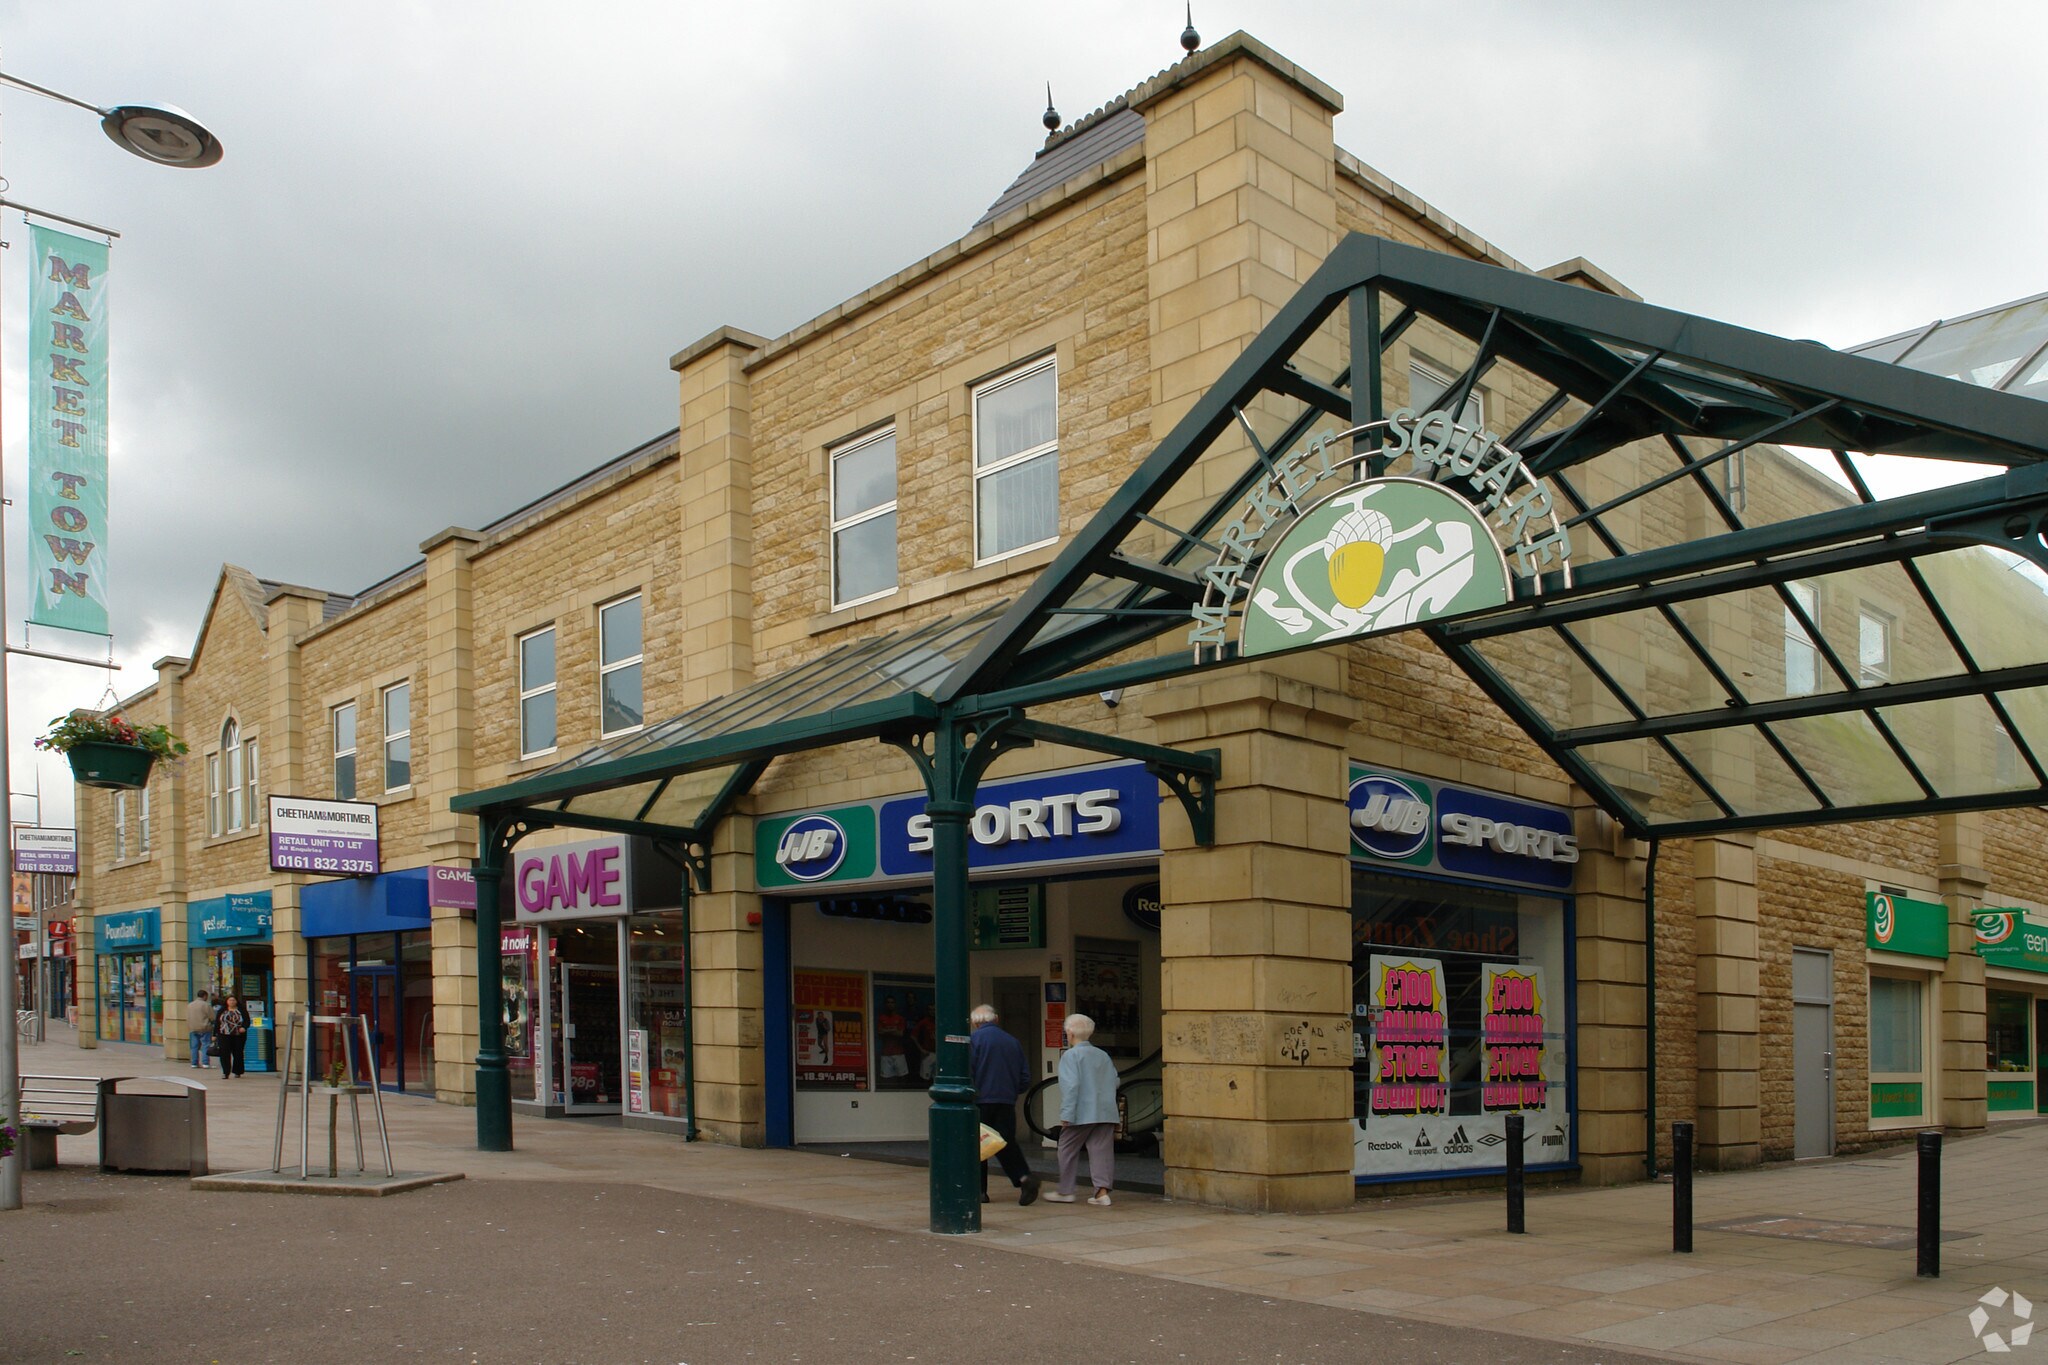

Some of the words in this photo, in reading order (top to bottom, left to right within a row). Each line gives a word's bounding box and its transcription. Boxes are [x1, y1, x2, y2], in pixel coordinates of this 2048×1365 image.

[47, 255, 91, 448] MARKET
[44, 471, 95, 599] TOWN
[1188, 428, 1337, 646] MARKET
[1381, 408, 1572, 577] SQUARE
[775, 829, 837, 864] JJB
[907, 788, 1121, 852] SORTS
[1351, 794, 1430, 836] JJB
[1441, 813, 1579, 864] SPORTS
[279, 837, 308, 846] RETAIL
[311, 839, 330, 847] UNIT
[333, 840, 344, 848] TO
[347, 841, 362, 849] LET
[39, 863, 53, 871] 832
[55, 864, 74, 872] 3375
[278, 855, 309, 868] 0161
[314, 857, 338, 870] 832
[342, 859, 373, 872] 3375
[437, 870, 475, 883] GAME
[518, 846, 621, 913] GAME
[232, 897, 253, 905] yes!
[105, 919, 136, 940] Poundland
[203, 915, 216, 934] yes!
[257, 915, 273, 925] £1
[509, 934, 529, 949] now!
[795, 986, 863, 1008] OFFER
[1385, 968, 1433, 1007] £100
[1493, 974, 1533, 1011] £100
[1376, 1010, 1443, 1043] MILLION
[1485, 1013, 1543, 1044] MILLION
[1381, 1045, 1439, 1077] STOCK
[1490, 1046, 1538, 1077] STOCK
[803, 1072, 834, 1081] 18.9%
[836, 1073, 855, 1081] APR
[1420, 1083, 1446, 1109] OUT
[1523, 1081, 1546, 1104] OUT
[1367, 1141, 1402, 1151] Reebok
[1443, 1143, 1473, 1154] adidas
[1542, 1135, 1564, 1147] PUMA
